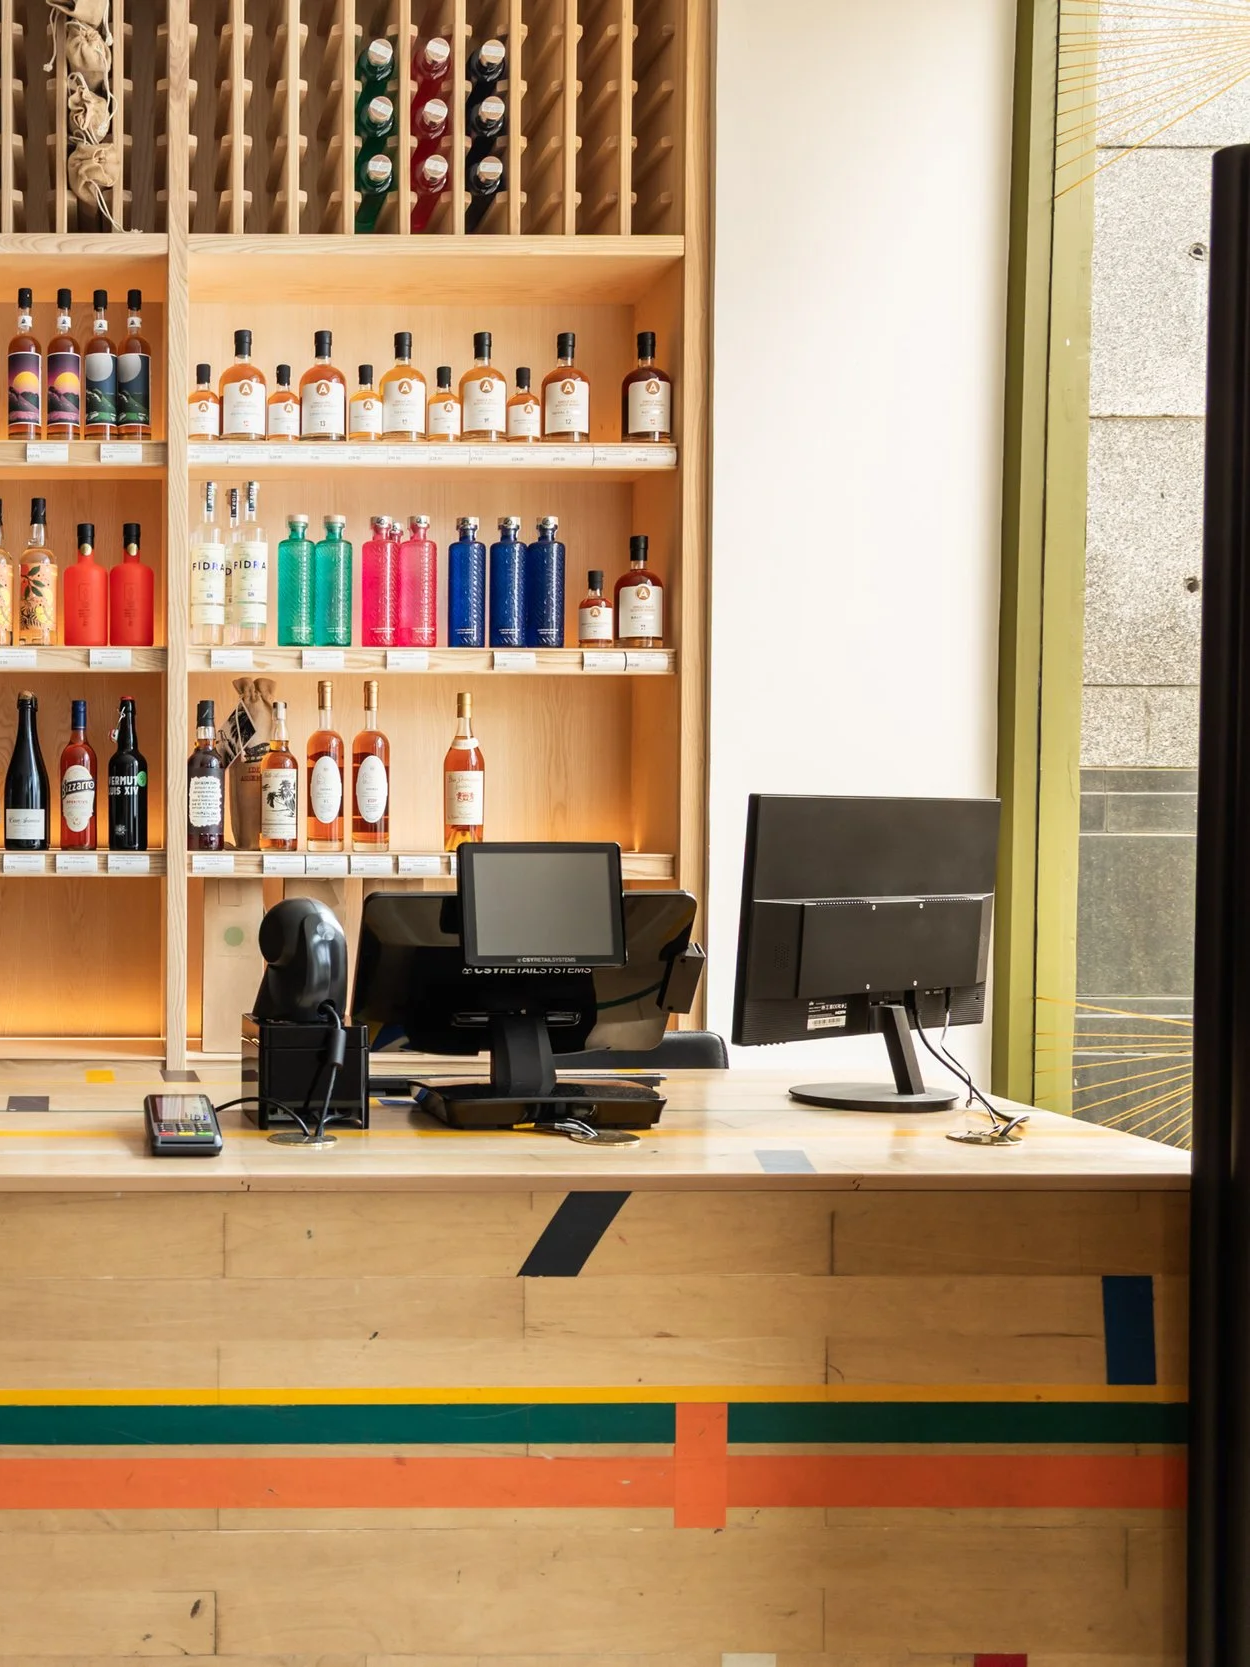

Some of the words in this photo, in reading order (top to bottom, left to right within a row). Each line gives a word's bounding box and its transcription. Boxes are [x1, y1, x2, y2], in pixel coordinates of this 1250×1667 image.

[192, 562, 225, 572] FIDRA
[233, 560, 266, 570] FIDRA
[124, 786, 139, 795] XIV
